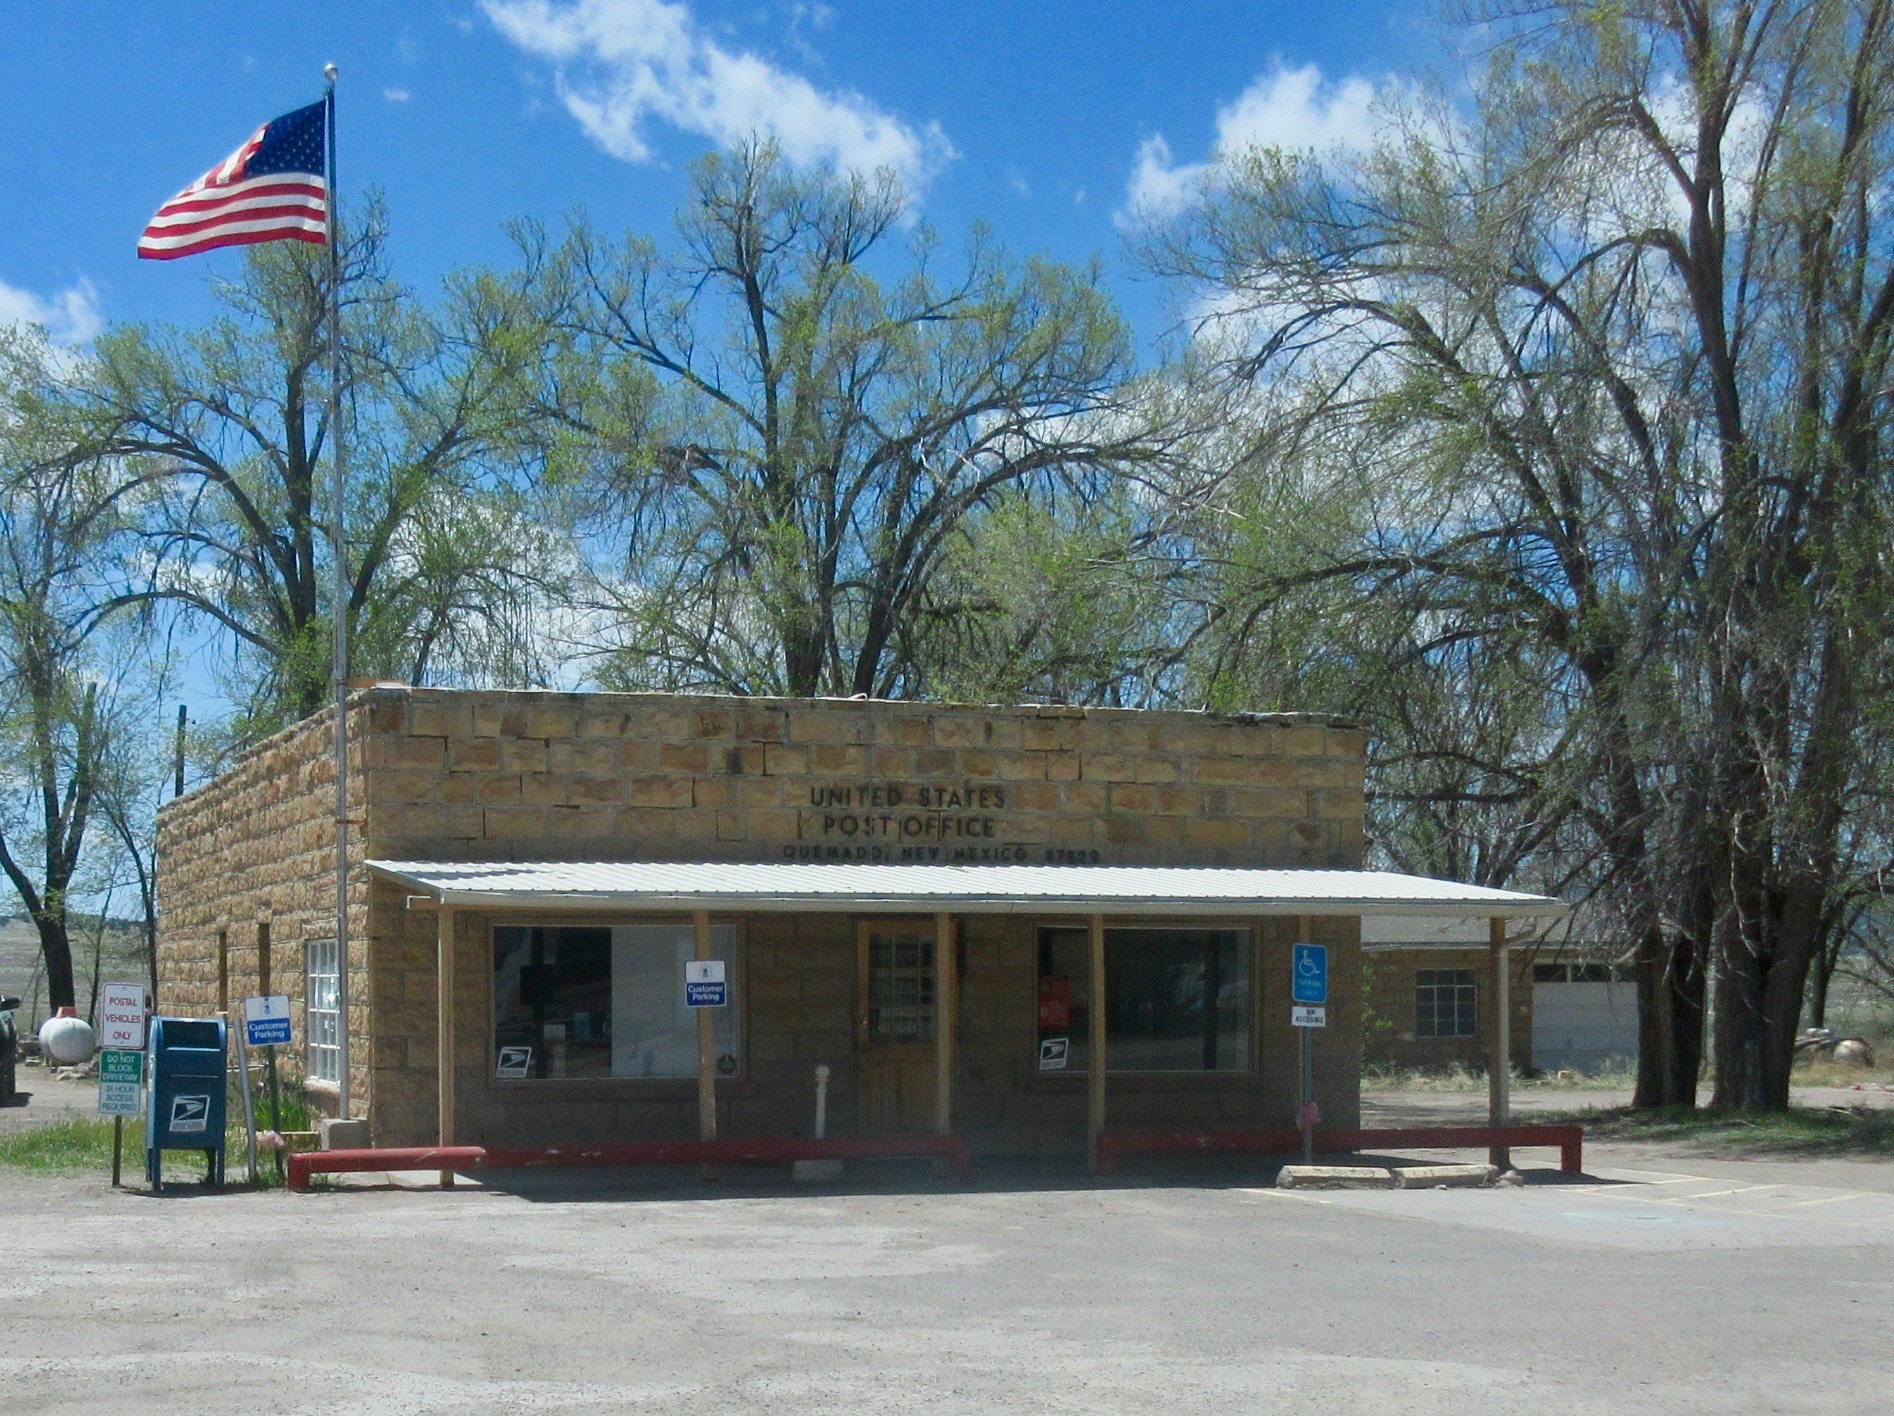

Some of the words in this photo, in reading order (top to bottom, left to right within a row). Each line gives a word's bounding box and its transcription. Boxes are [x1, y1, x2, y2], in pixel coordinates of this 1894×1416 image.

[811, 786, 900, 808] UNITED
[918, 785, 1005, 809] STATES
[824, 815, 891, 836] POST
[904, 816, 995, 838] OFFICE
[902, 846, 939, 860] NEW
[953, 847, 1027, 862] MEXICO
[688, 985, 723, 993] Customer
[109, 996, 137, 1007] POSTAL
[692, 993, 720, 1001] Parking
[105, 1013, 141, 1024] VEHICLES
[249, 1022, 288, 1031] Customer
[112, 1031, 132, 1040] ONLY
[254, 1030, 285, 1039] Parking
[107, 1055, 118, 1063] DO
[120, 1055, 136, 1064] NOT
[108, 1063, 133, 1072] BLOCK
